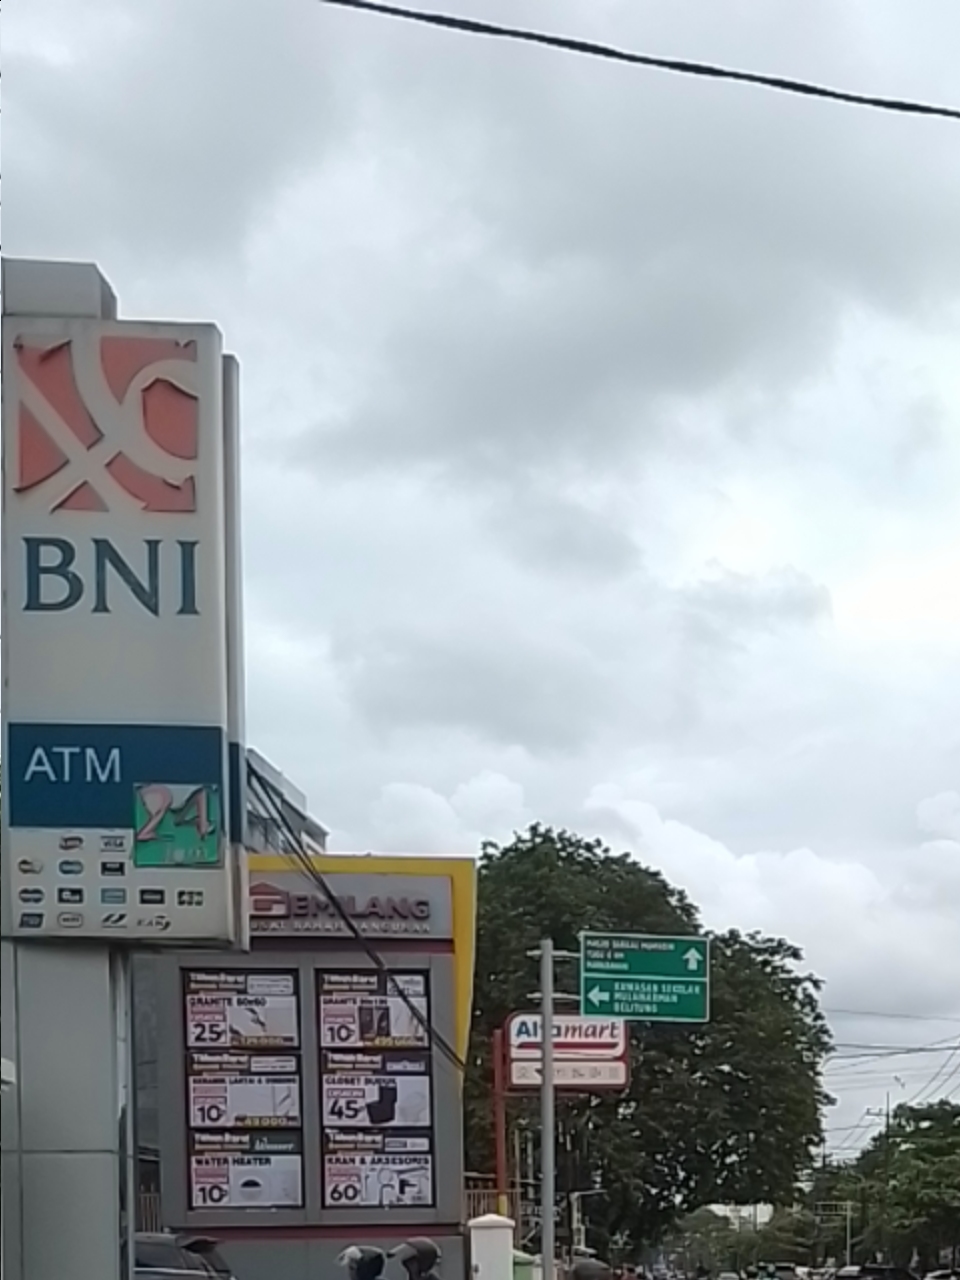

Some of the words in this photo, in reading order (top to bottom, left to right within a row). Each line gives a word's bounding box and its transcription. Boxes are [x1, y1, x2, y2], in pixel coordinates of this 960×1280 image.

[22, 536, 201, 617] BNI
[24, 747, 122, 783] ATM
[516, 1021, 619, 1039] Alamart
